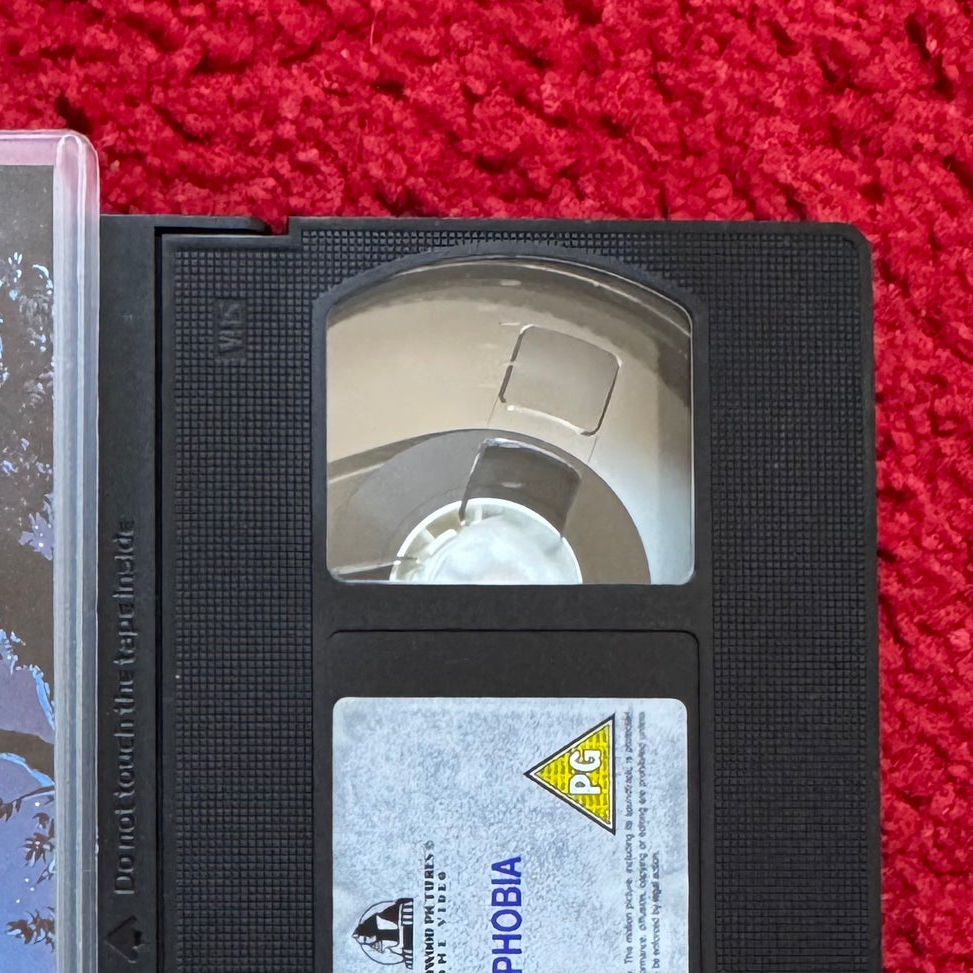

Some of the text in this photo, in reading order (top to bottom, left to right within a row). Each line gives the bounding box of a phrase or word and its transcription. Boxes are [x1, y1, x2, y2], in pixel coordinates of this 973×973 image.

[112, 603, 139, 665] tape
[112, 671, 136, 715] the
[112, 719, 136, 798] touch
[567, 748, 602, 796] PG
[113, 805, 137, 850] not
[113, 856, 136, 894] Do
[437, 871, 447, 927] VIDEO
